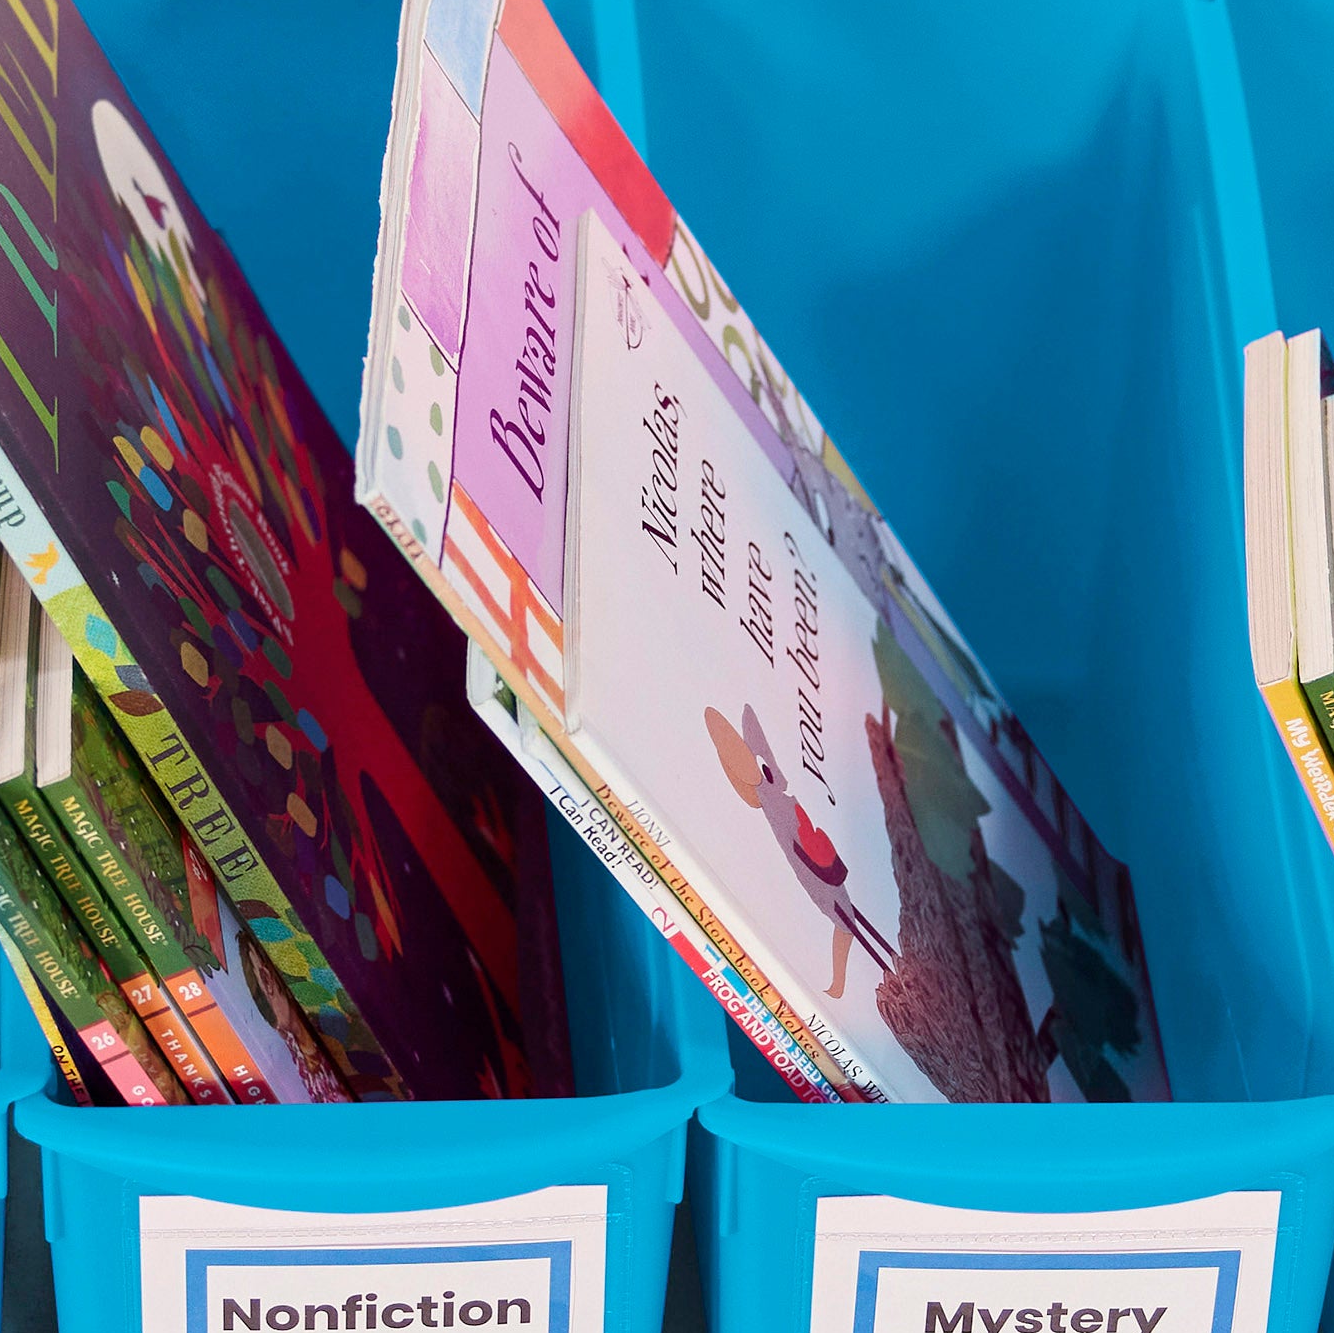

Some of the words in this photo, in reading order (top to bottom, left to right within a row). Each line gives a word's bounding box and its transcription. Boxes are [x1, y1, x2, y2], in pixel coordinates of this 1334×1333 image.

[508, 140, 562, 256] of
[640, 379, 687, 576] Nicolas,
[689, 457, 729, 611] where
[739, 541, 775, 669] have
[783, 529, 821, 683] been?
[797, 679, 837, 807] you
[1285, 717, 1312, 748] My
[146, 733, 259, 883] TREE
[549, 785, 562, 795] I
[558, 795, 584, 825] Can
[583, 826, 623, 869] Read!
[581, 799, 590, 808] I
[589, 807, 620, 843] CAN
[617, 842, 659, 890] READ!
[627, 800, 672, 848] LIONNI
[14, 798, 57, 852] MAGIC
[50, 845, 81, 892] TREE
[77, 896, 119, 948] HOUSE
[61, 795, 104, 849] MAGIC
[96, 844, 129, 891] TREE
[123, 892, 166, 946] HOUSE
[596, 784, 650, 849] Beware
[652, 853, 674, 871] of
[670, 876, 694, 904] the
[696, 906, 770, 999] Storybook
[773, 999, 820, 1060] Wolves
[651, 906, 675, 933] 2
[12, 909, 42, 951] TREE
[35, 950, 78, 1000] HOUSE
[131, 984, 152, 1005] 27
[178, 982, 203, 1002] 28
[91, 1032, 116, 1050] 26
[702, 968, 744, 1013] FROG
[736, 1012, 772, 1047] AND
[767, 1043, 806, 1086] TOAD
[742, 991, 769, 1020] THE
[766, 1018, 793, 1050] BAD
[790, 1047, 822, 1086] SEED
[821, 1082, 844, 1103] GO
[222, 1289, 531, 1331] Nonfiction
